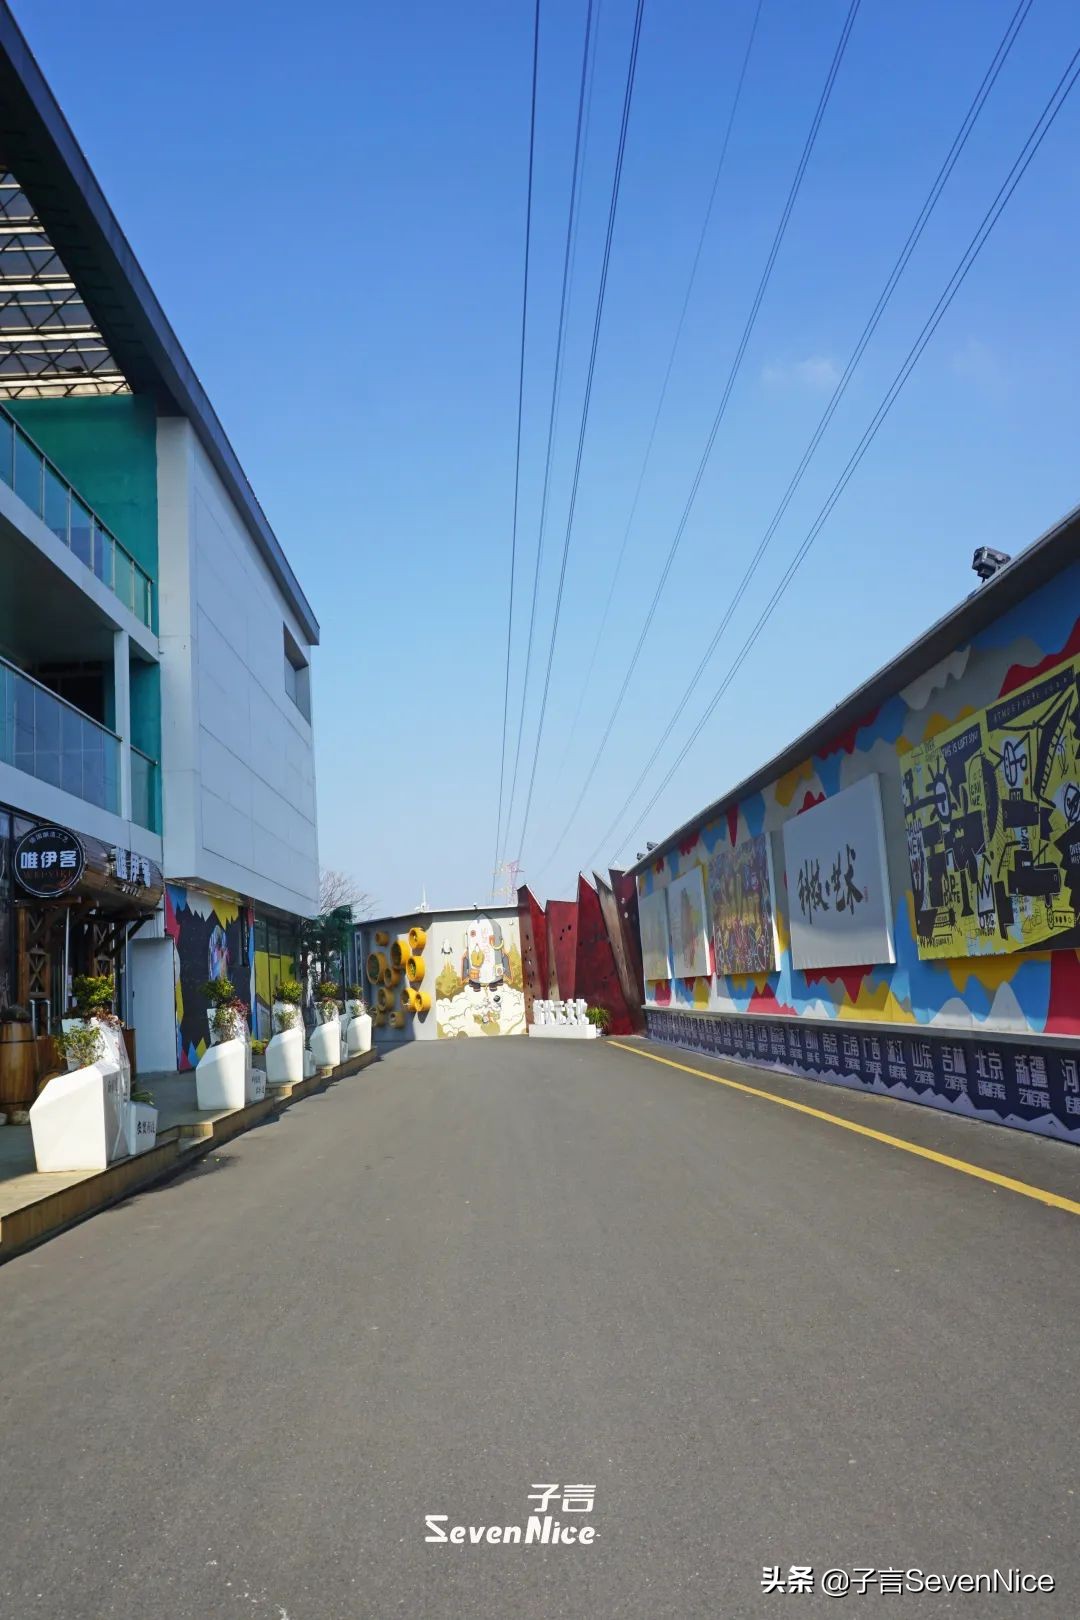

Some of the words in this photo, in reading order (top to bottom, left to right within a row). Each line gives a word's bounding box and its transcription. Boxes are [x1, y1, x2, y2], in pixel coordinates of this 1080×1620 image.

[20, 850, 77, 869] 唯伊客
[911, 1041, 933, 1070] 山东
[941, 1046, 967, 1075] 吉林
[975, 1049, 1004, 1081] 北京
[1014, 1054, 1049, 1088] 新疆
